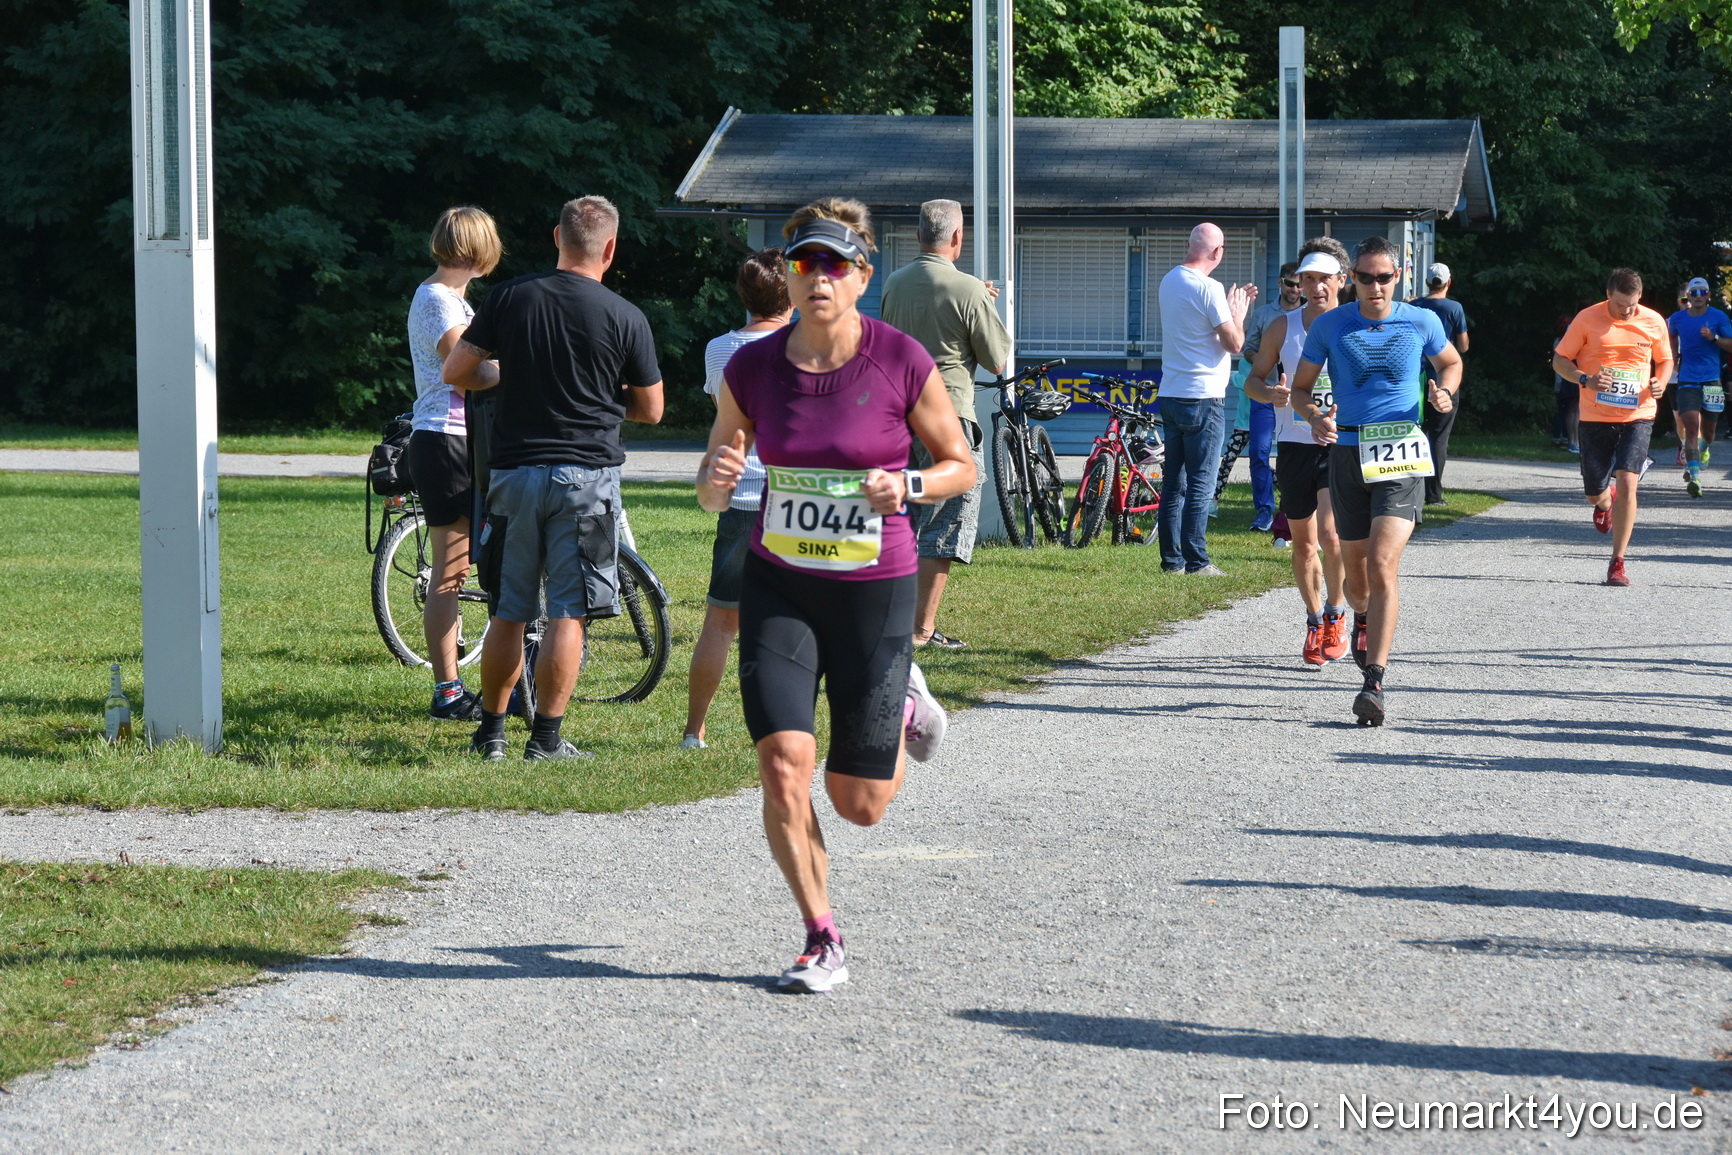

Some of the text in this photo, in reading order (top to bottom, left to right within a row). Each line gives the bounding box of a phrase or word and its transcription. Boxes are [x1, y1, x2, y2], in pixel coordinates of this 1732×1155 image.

[1607, 382, 1635, 396] 534
[1600, 394, 1635, 404] CHRISTOPH
[1368, 441, 1420, 462] 1211
[1379, 464, 1417, 474] DANIEL
[781, 499, 866, 534] 1044
[797, 541, 839, 557] SINA
